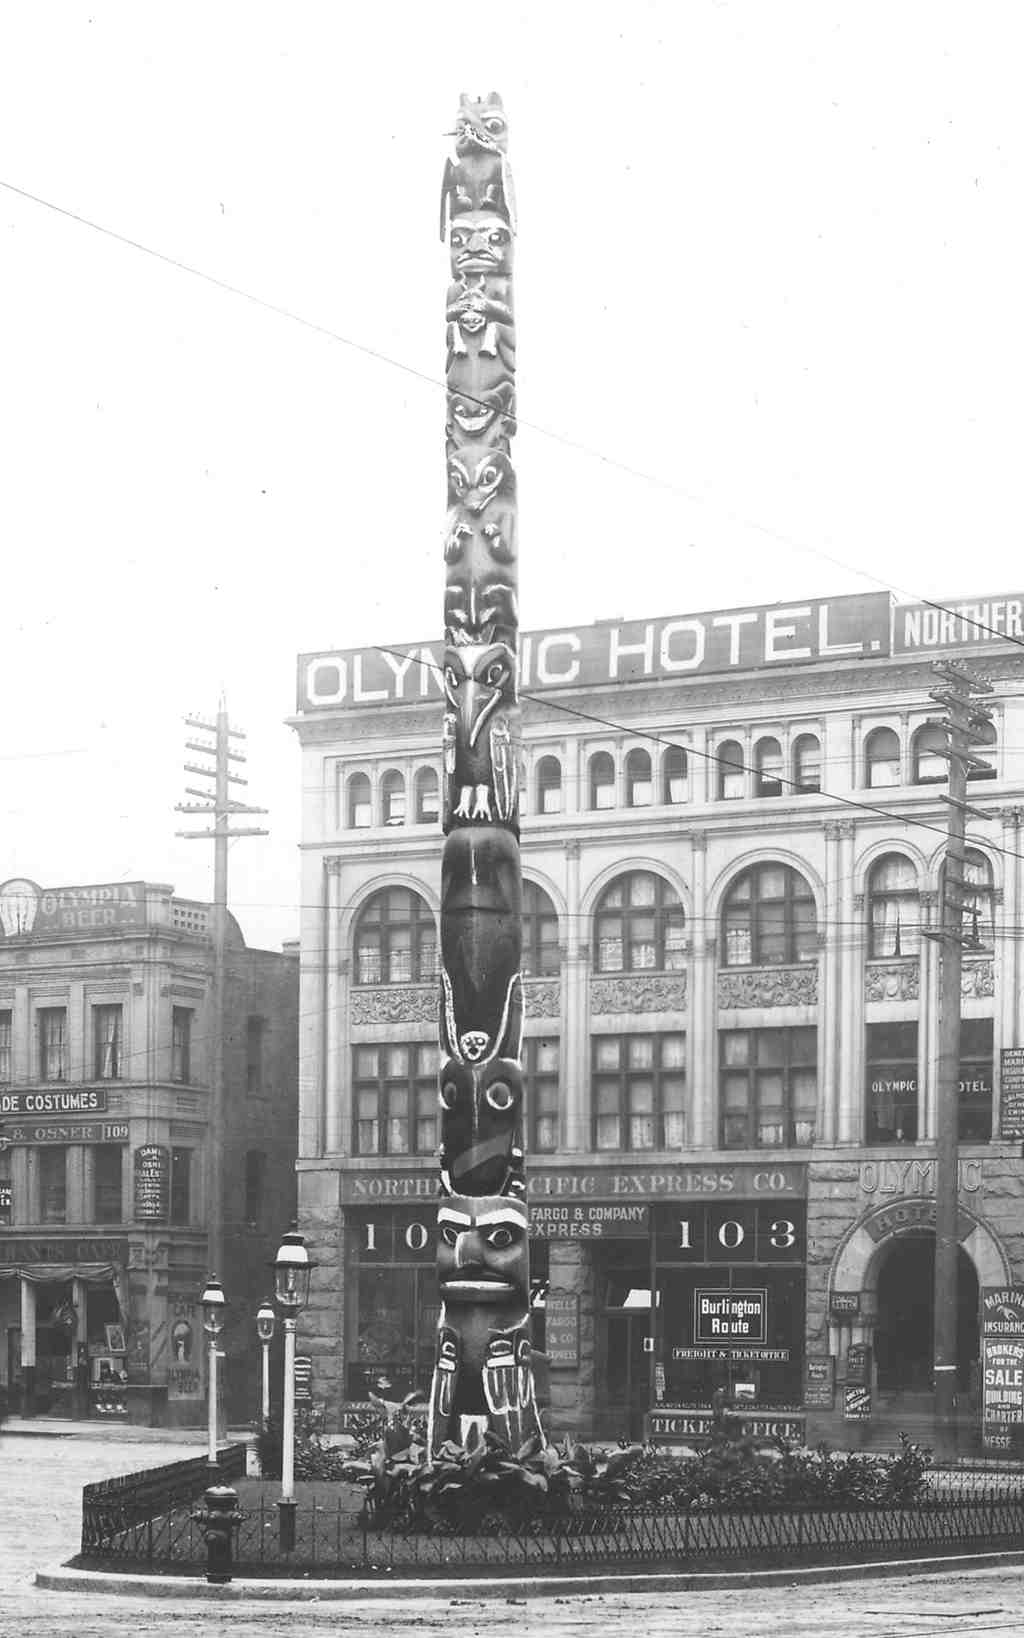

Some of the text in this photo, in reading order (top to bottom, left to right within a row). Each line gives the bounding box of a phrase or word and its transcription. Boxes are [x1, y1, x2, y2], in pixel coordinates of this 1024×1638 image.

[307, 604, 880, 705] OLYMIC HOTEL.
[872, 1079, 916, 1093] OLYMPIC
[959, 1079, 992, 1093] OTEL.
[26, 1093, 97, 1110] COSTUMES
[35, 1126, 93, 1140] OSNER
[106, 1125, 128, 1138] 109
[613, 1173, 734, 1193] EXPRESS
[753, 1172, 793, 1192] CO.
[531, 1206, 645, 1221] FARGO & COMPANY
[527, 1223, 602, 1237] EXPRESS
[701, 1298, 761, 1318] Burlington
[711, 1318, 750, 1334] Route
[985, 1369, 1022, 1386] SALE
